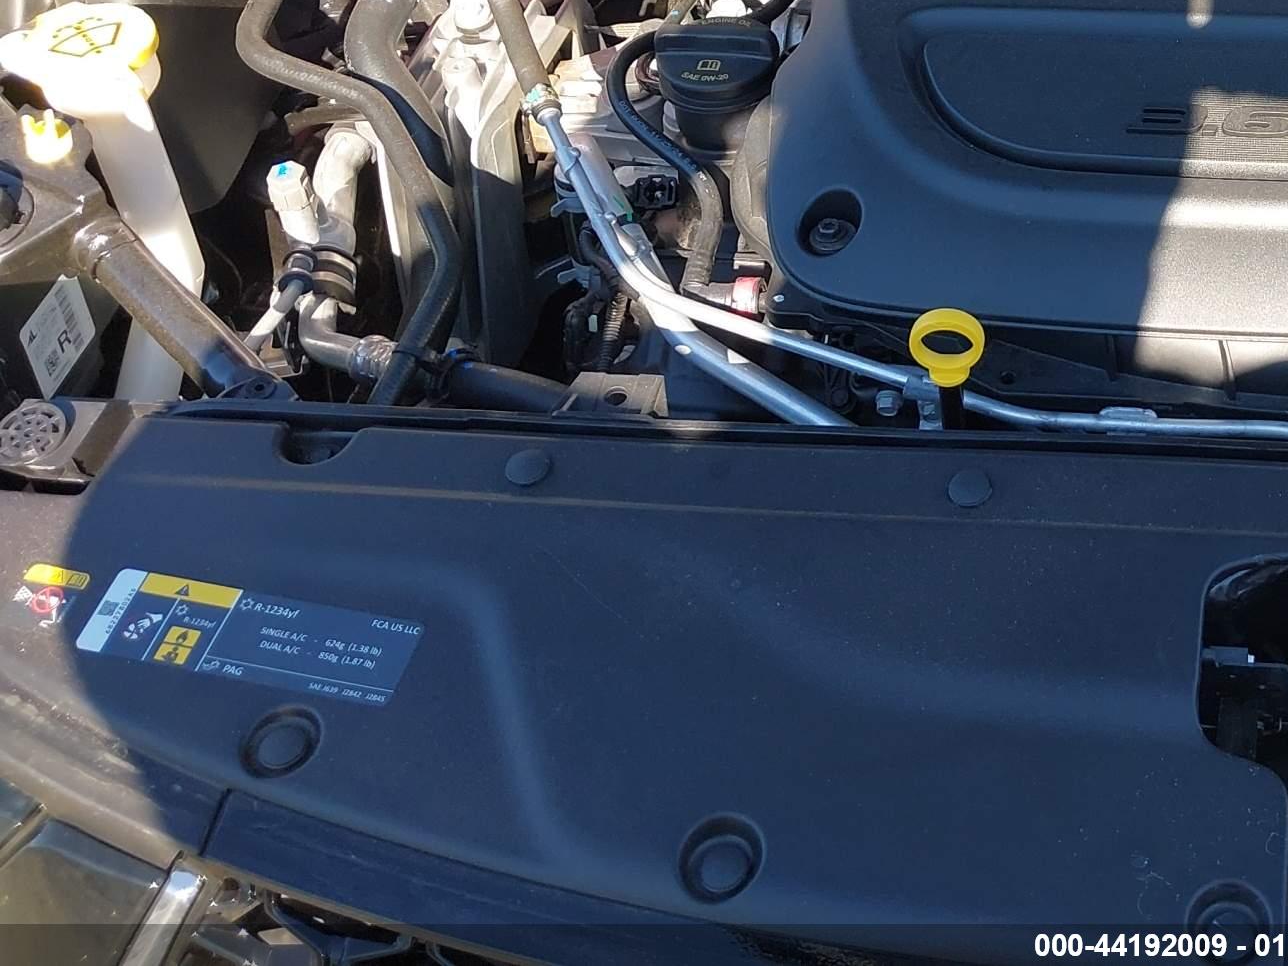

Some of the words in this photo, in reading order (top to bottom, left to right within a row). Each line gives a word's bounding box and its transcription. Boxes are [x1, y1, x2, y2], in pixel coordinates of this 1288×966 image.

[681, 71, 701, 81] SAE
[701, 73, 729, 82] 0W-20
[57, 329, 72, 354] R
[254, 602, 300, 619] R-1234yf
[371, 619, 389, 630] FCA
[390, 622, 403, 632] US
[405, 625, 421, 636] LLC
[260, 626, 290, 640] SINGLE
[291, 632, 308, 643] A/C
[325, 638, 345, 651] 624g
[349, 642, 369, 655] (1.38
[370, 645, 383, 657] lb)
[259, 640, 282, 651] DUAL
[284, 644, 300, 656] A/C
[318, 651, 338, 664] 850g
[341, 654, 362, 667] (1.87
[363, 657, 376, 670] lb)
[222, 664, 245, 676] PAG
